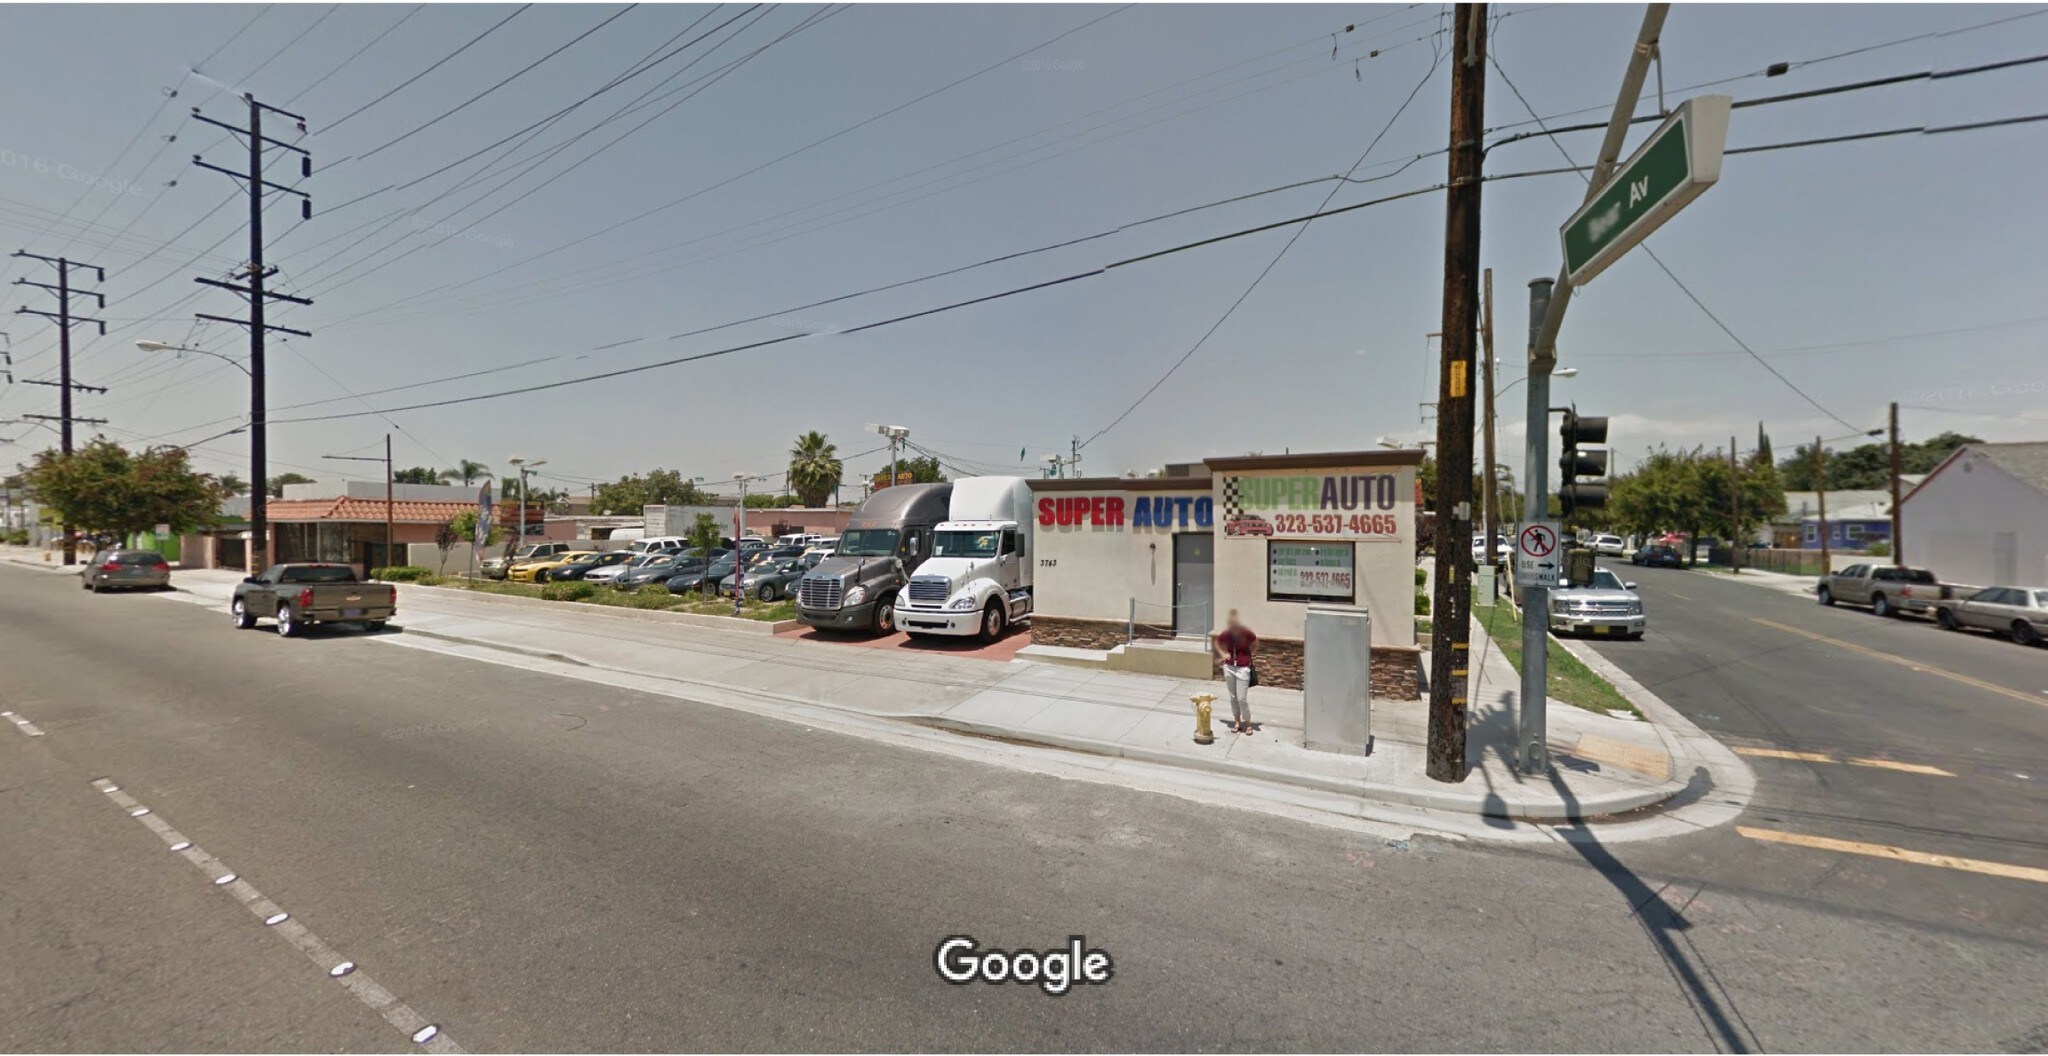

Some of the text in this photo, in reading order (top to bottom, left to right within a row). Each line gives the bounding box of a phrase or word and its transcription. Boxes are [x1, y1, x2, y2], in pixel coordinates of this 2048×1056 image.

[1629, 175, 1649, 209] Av
[1038, 496, 1214, 528] SUPER AUTO
[1275, 513, 1397, 535] 323-537-4665
[1521, 560, 1534, 569] USE
